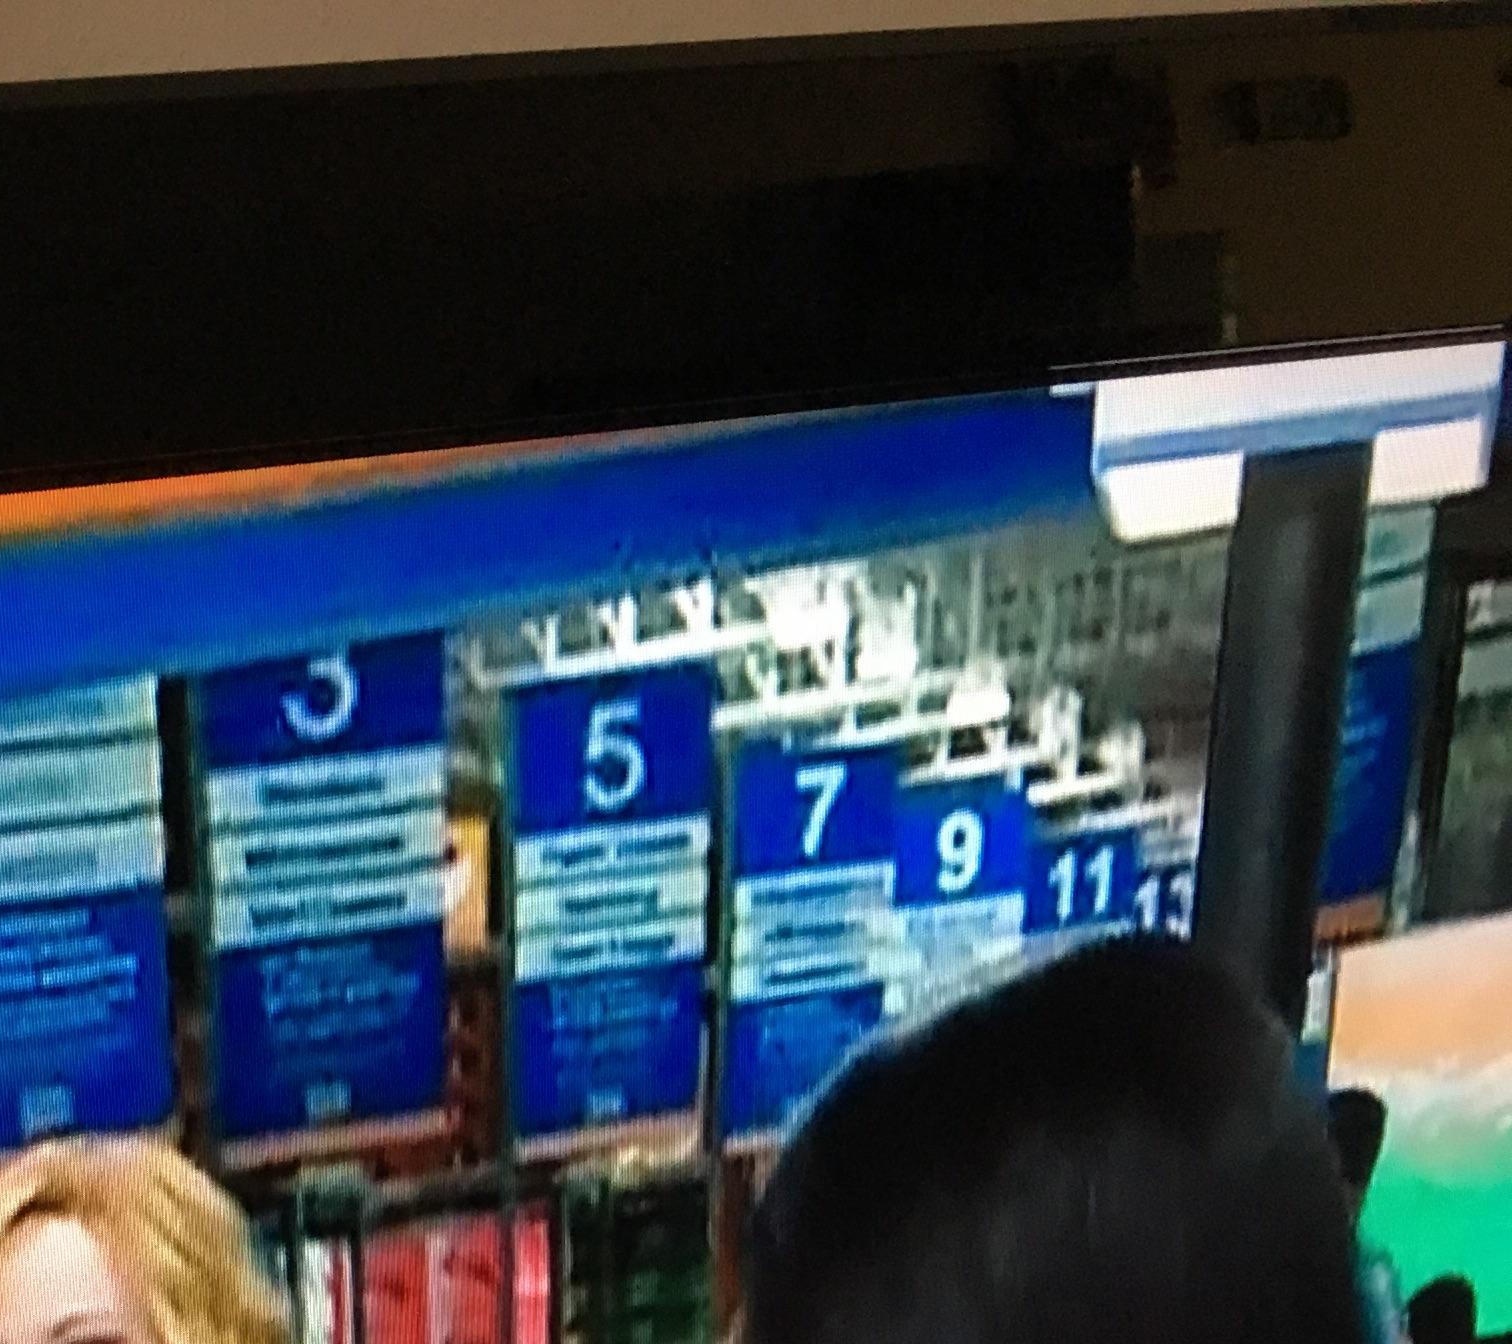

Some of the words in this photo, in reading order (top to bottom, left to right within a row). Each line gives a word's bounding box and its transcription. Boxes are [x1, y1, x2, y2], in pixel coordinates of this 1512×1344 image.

[583, 700, 646, 812] 5
[796, 762, 848, 858] 7
[936, 808, 985, 892] 9
[1049, 844, 1115, 923] 11
